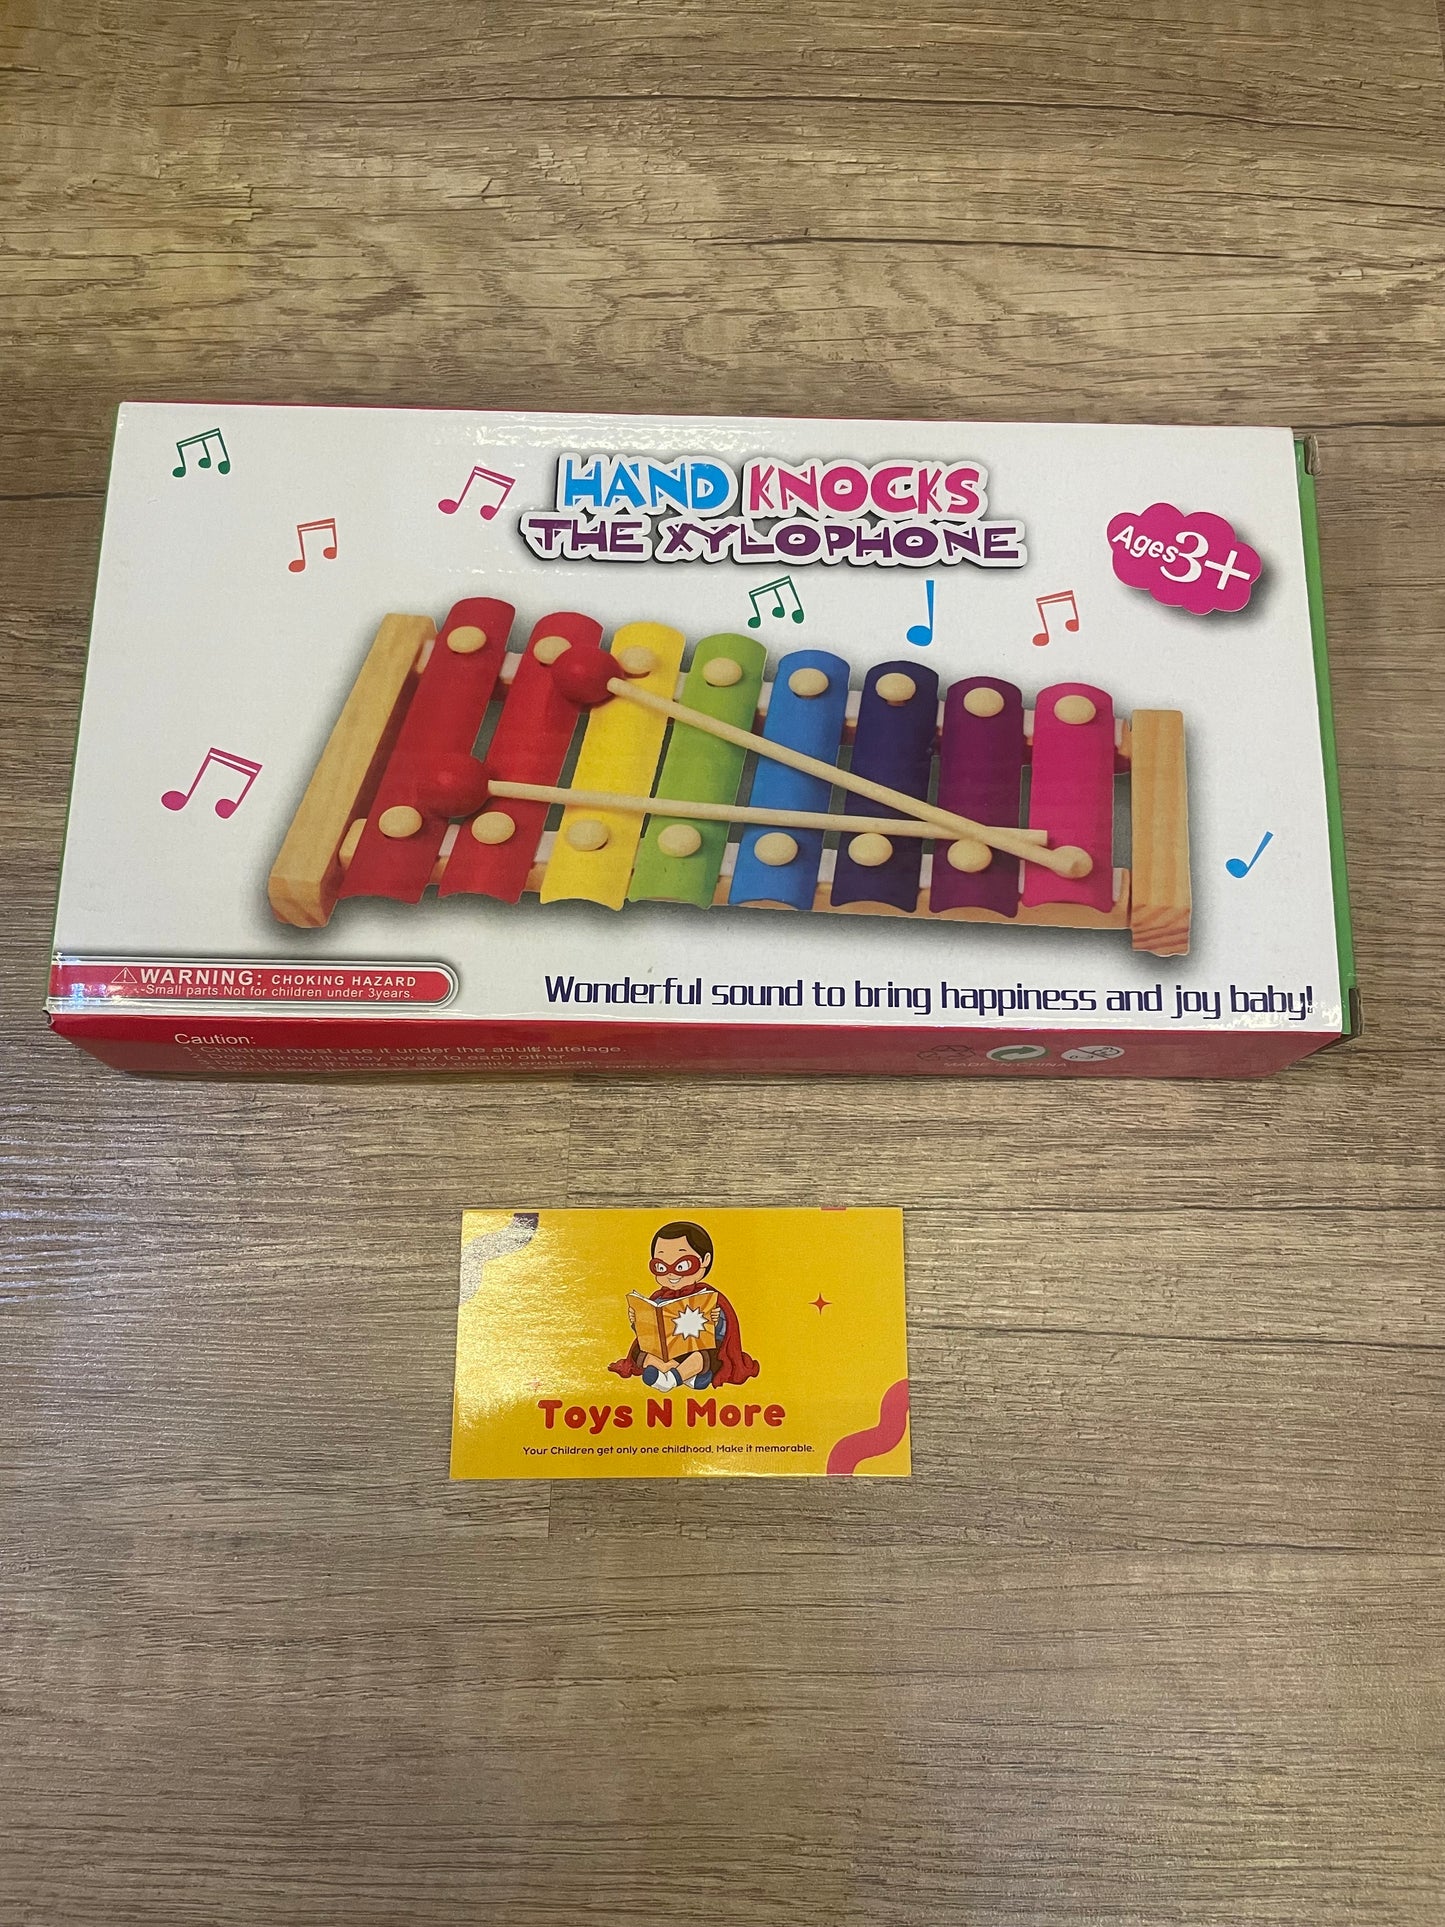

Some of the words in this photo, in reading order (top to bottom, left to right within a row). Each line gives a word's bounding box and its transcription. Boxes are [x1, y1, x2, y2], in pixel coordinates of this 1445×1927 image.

[563, 459, 730, 512] HAND
[750, 463, 982, 515] KNOCKS
[528, 518, 644, 553] THE
[662, 522, 1019, 560] XYLOPHONE
[1112, 525, 1179, 563] Ages
[140, 968, 262, 986] WARNING:
[271, 974, 345, 986] CHOKING
[352, 976, 417, 987] HAZARD
[250, 986, 267, 996] for
[271, 987, 322, 998] children
[327, 987, 364, 998] under
[545, 975, 702, 1006] Wonderful
[712, 979, 803, 1008] sound
[812, 981, 846, 1008] to
[855, 980, 932, 1016] bring
[941, 981, 1097, 1017] happiness
[1106, 984, 1163, 1012] and
[1171, 984, 1221, 1020] joy
[1230, 984, 1313, 1021] baby!
[174, 1033, 256, 1045] Caution:
[537, 1399, 634, 1435] Toys
[646, 1398, 673, 1428] N
[687, 1398, 787, 1428] More
[522, 1446, 549, 1456] Your
[550, 1446, 595, 1455] Children
[596, 1445, 614, 1456] get
[616, 1445, 638, 1456] only
[640, 1446, 660, 1454] one
[716, 1444, 744, 1453] Make
[746, 1443, 753, 1453] it
[755, 1443, 816, 1453] memorable.
